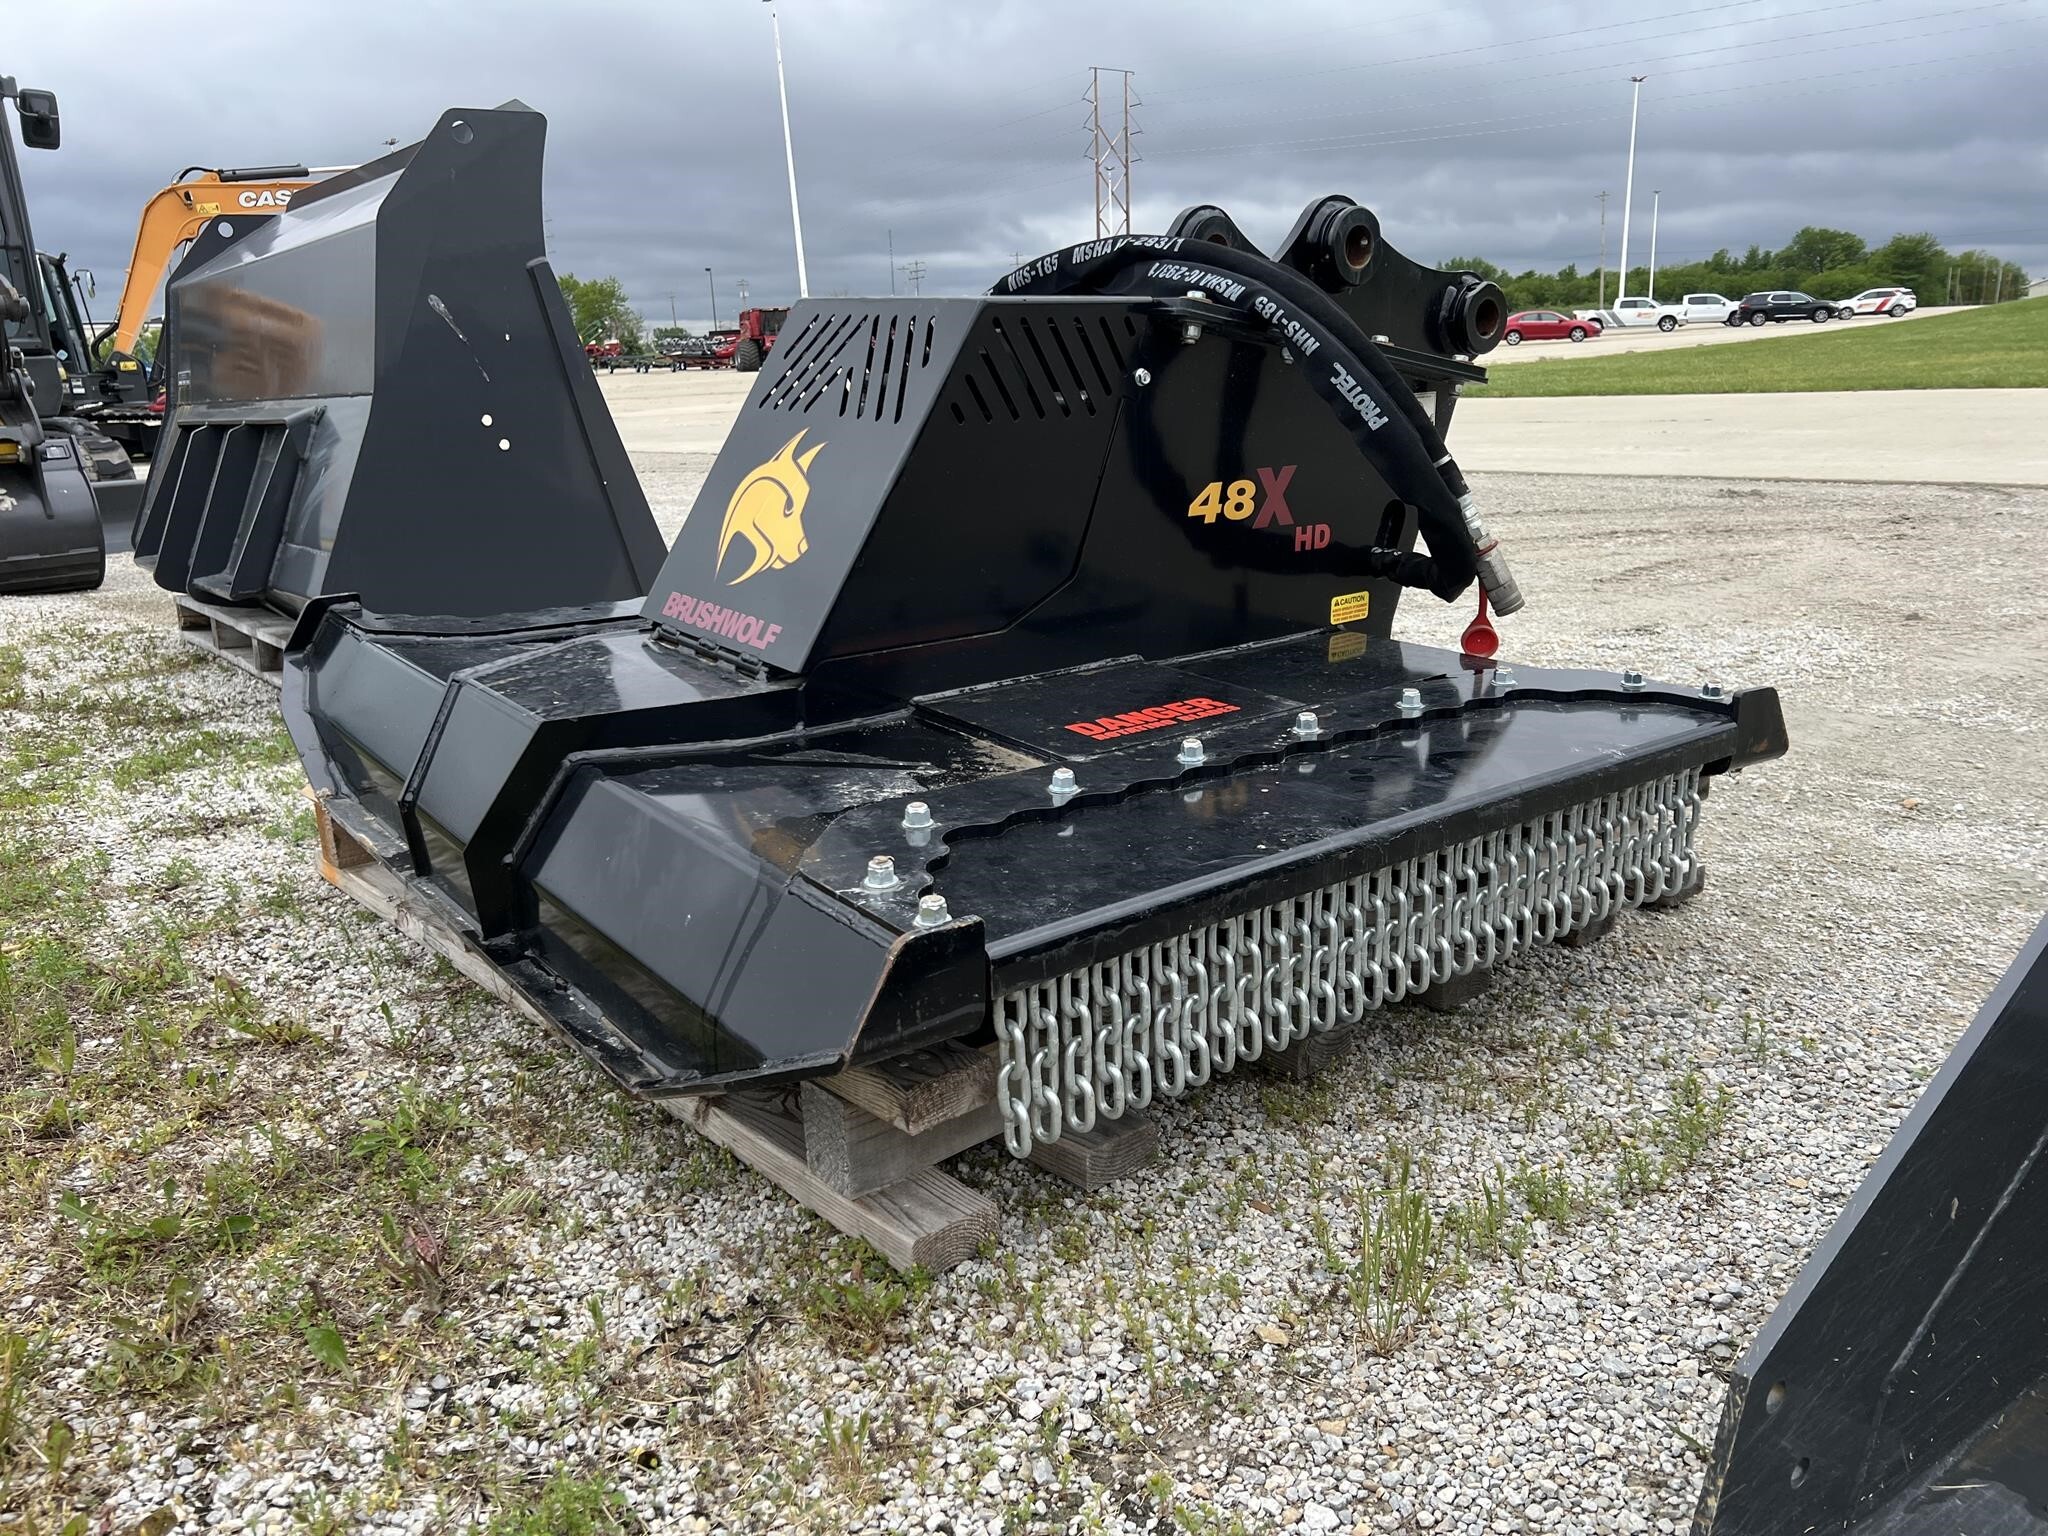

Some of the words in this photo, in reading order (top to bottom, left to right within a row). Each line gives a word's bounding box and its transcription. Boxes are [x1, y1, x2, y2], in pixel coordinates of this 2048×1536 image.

[238, 189, 300, 208] CAS
[1007, 254, 1060, 292] NHS-185
[1072, 239, 1112, 264] MSHA
[1147, 262, 1205, 284] IC-293/1
[1200, 273, 1247, 302] MSHA
[1254, 296, 1321, 357] NHS-185
[1294, 524, 1331, 552] HD
[1340, 595, 1366, 606] CAUTION
[662, 591, 783, 650] BRUSHWOLF
[1063, 697, 1229, 737] DANGER
